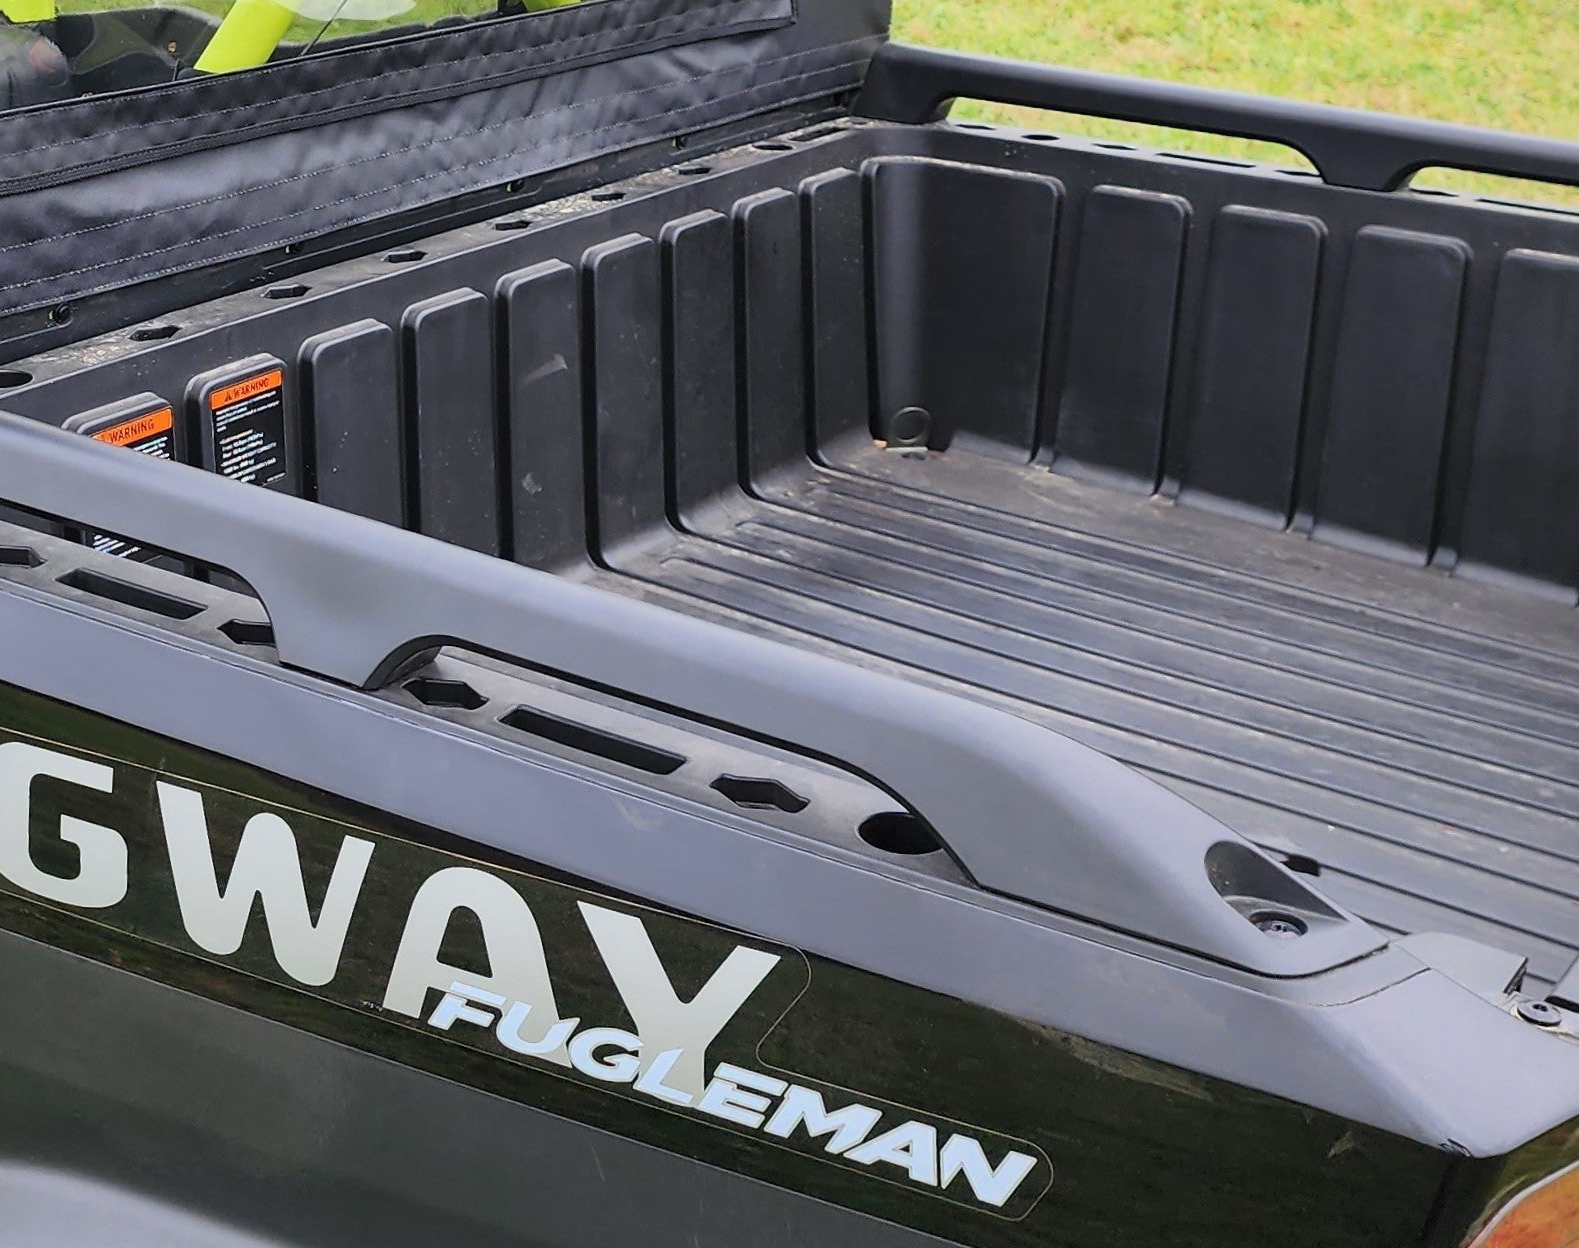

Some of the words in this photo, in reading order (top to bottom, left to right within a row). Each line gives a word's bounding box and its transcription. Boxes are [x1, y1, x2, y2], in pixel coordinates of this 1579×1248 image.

[233, 378, 269, 398] WARNING
[109, 419, 155, 443] WARNING
[427, 981, 1037, 1207] FUGLEMAN
